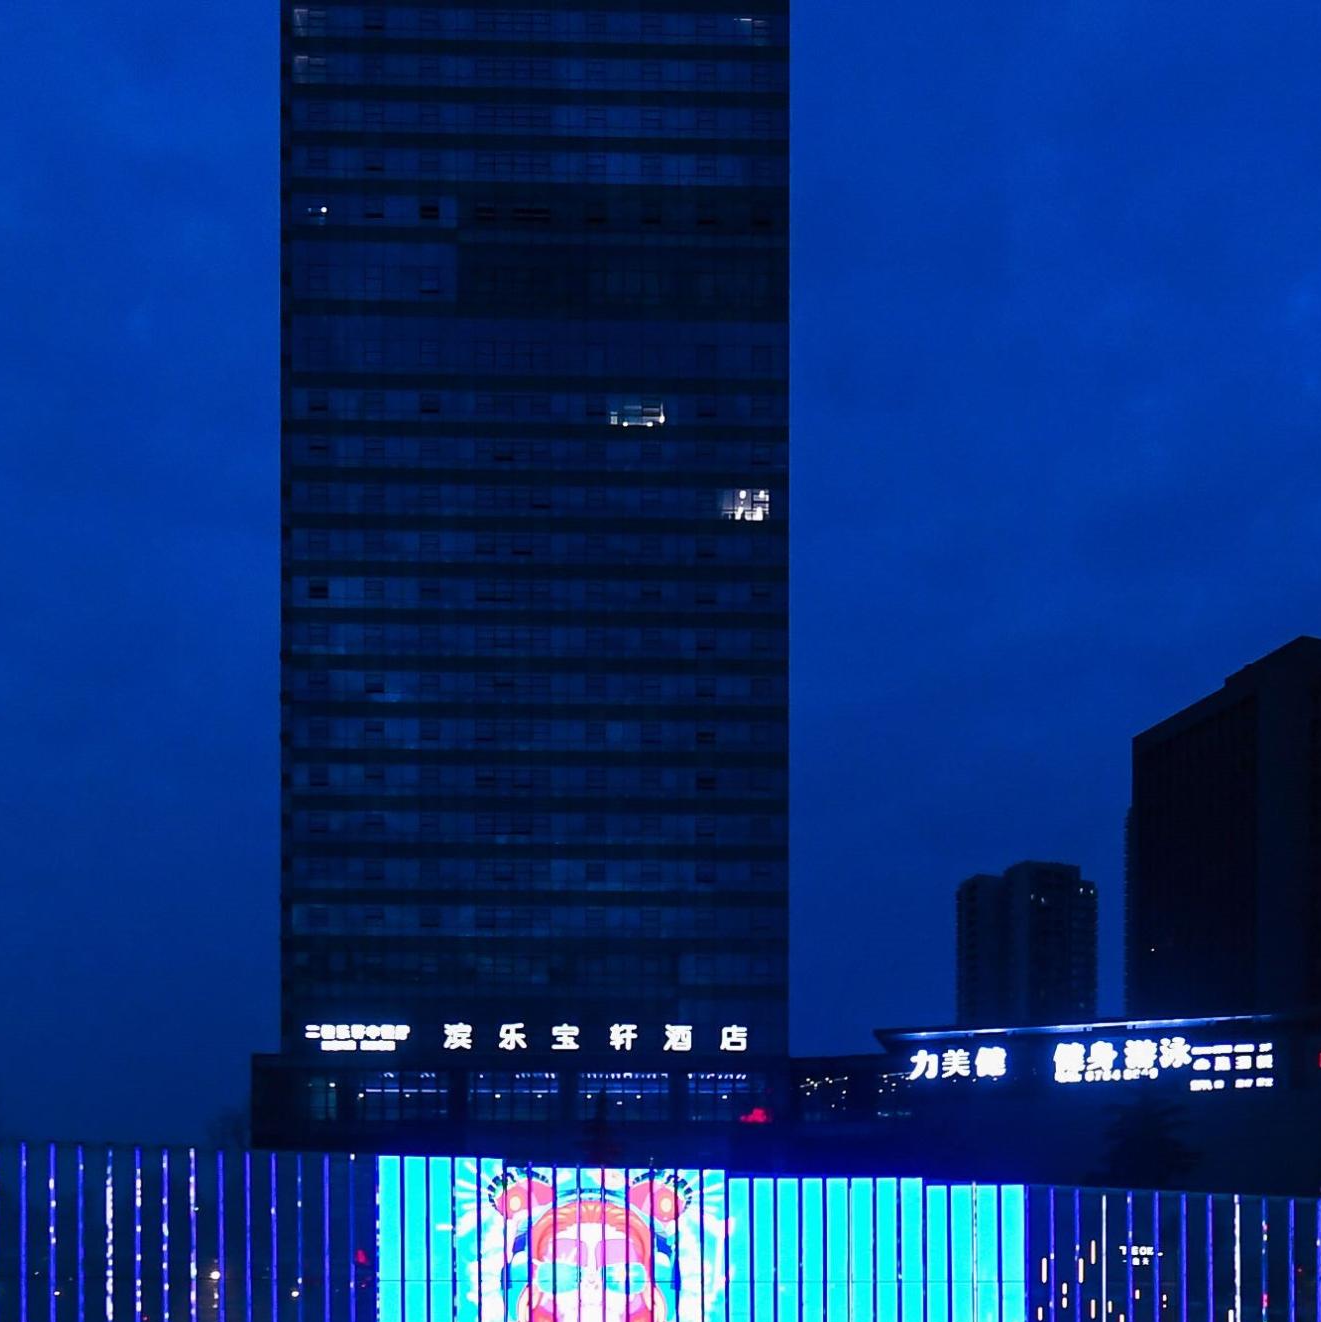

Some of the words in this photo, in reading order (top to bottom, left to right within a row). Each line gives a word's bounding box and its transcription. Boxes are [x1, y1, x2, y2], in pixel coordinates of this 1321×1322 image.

[443, 1022, 748, 1051] 滨乐宝轩酒店
[909, 1047, 1007, 1080] 力美健
